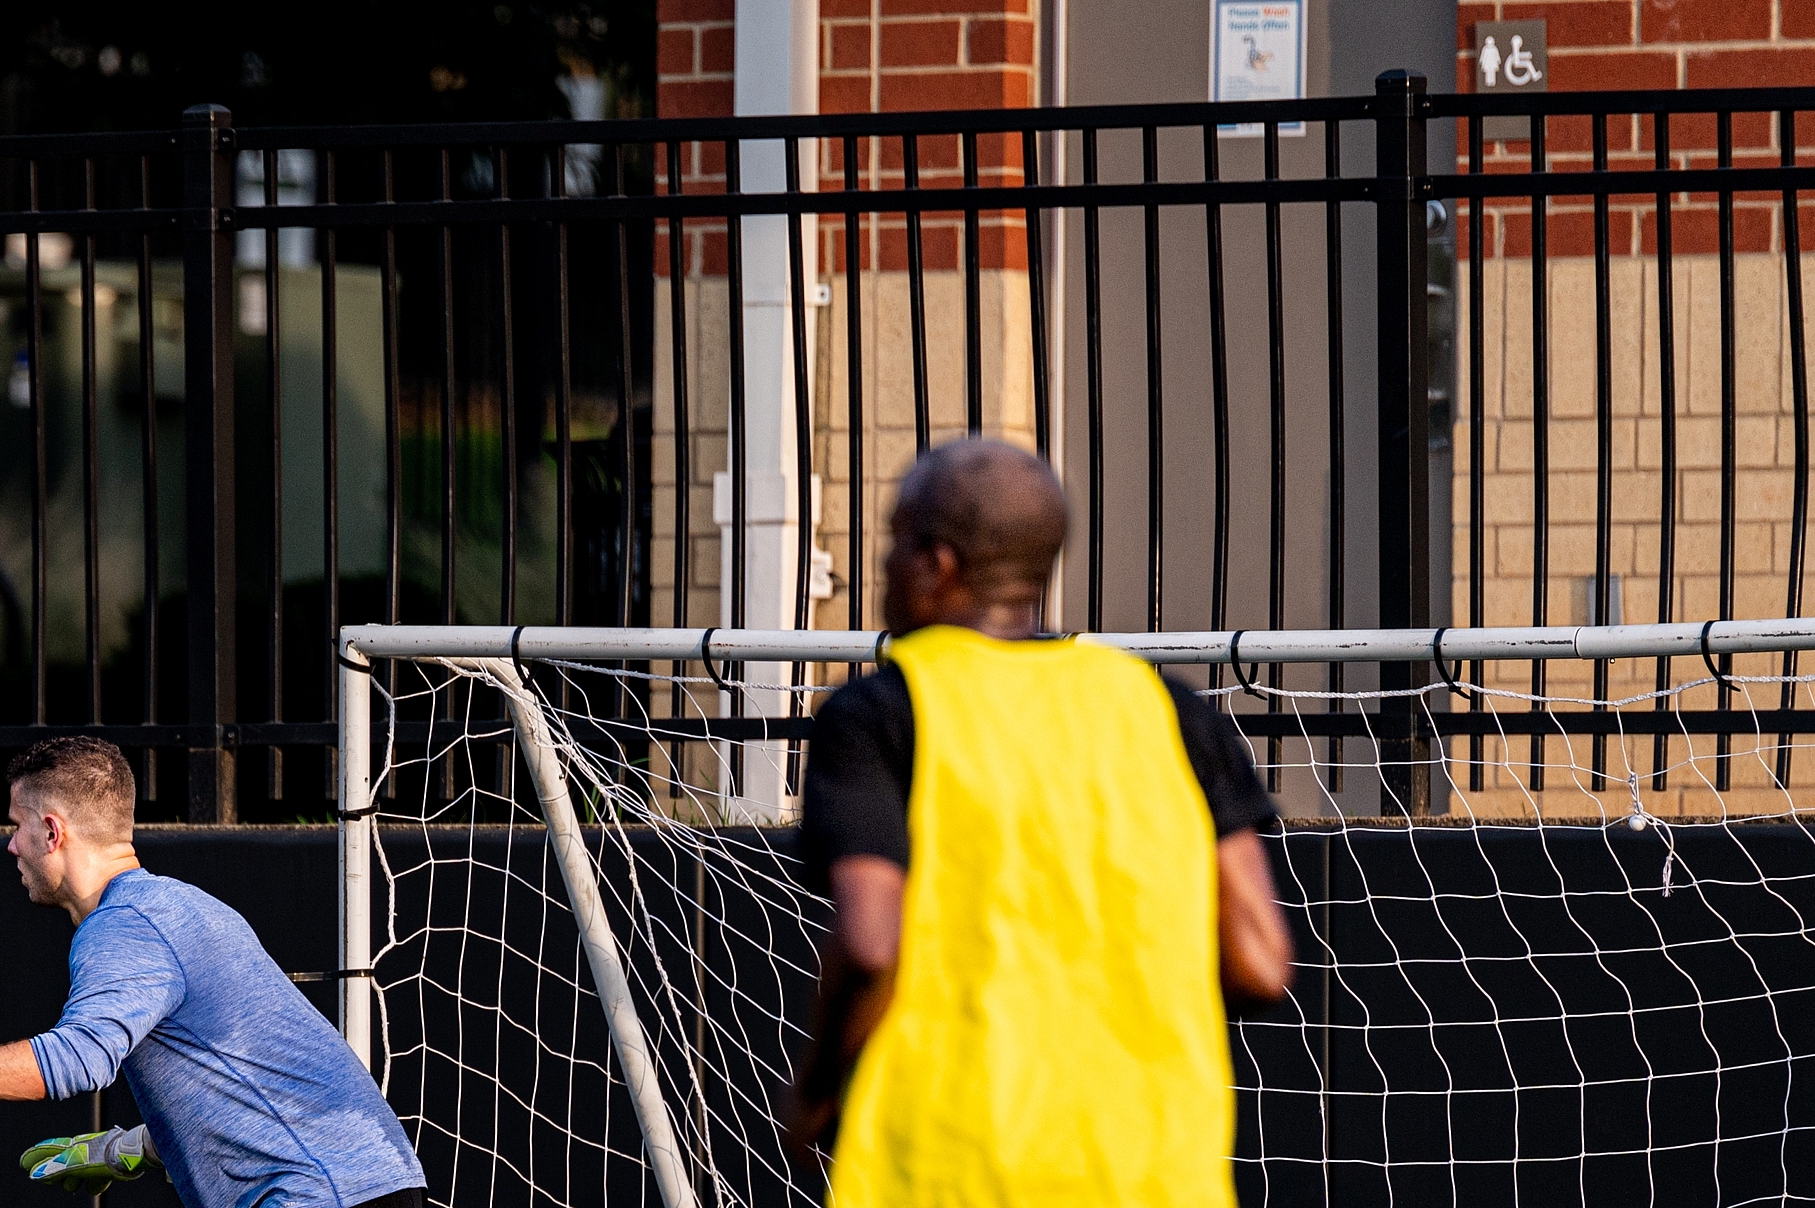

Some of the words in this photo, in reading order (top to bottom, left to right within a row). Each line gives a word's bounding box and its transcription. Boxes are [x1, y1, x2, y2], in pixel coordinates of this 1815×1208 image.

[1263, 7, 1289, 17] Wash
[1229, 21, 1259, 30] Hands
[1263, 21, 1288, 30] Often
